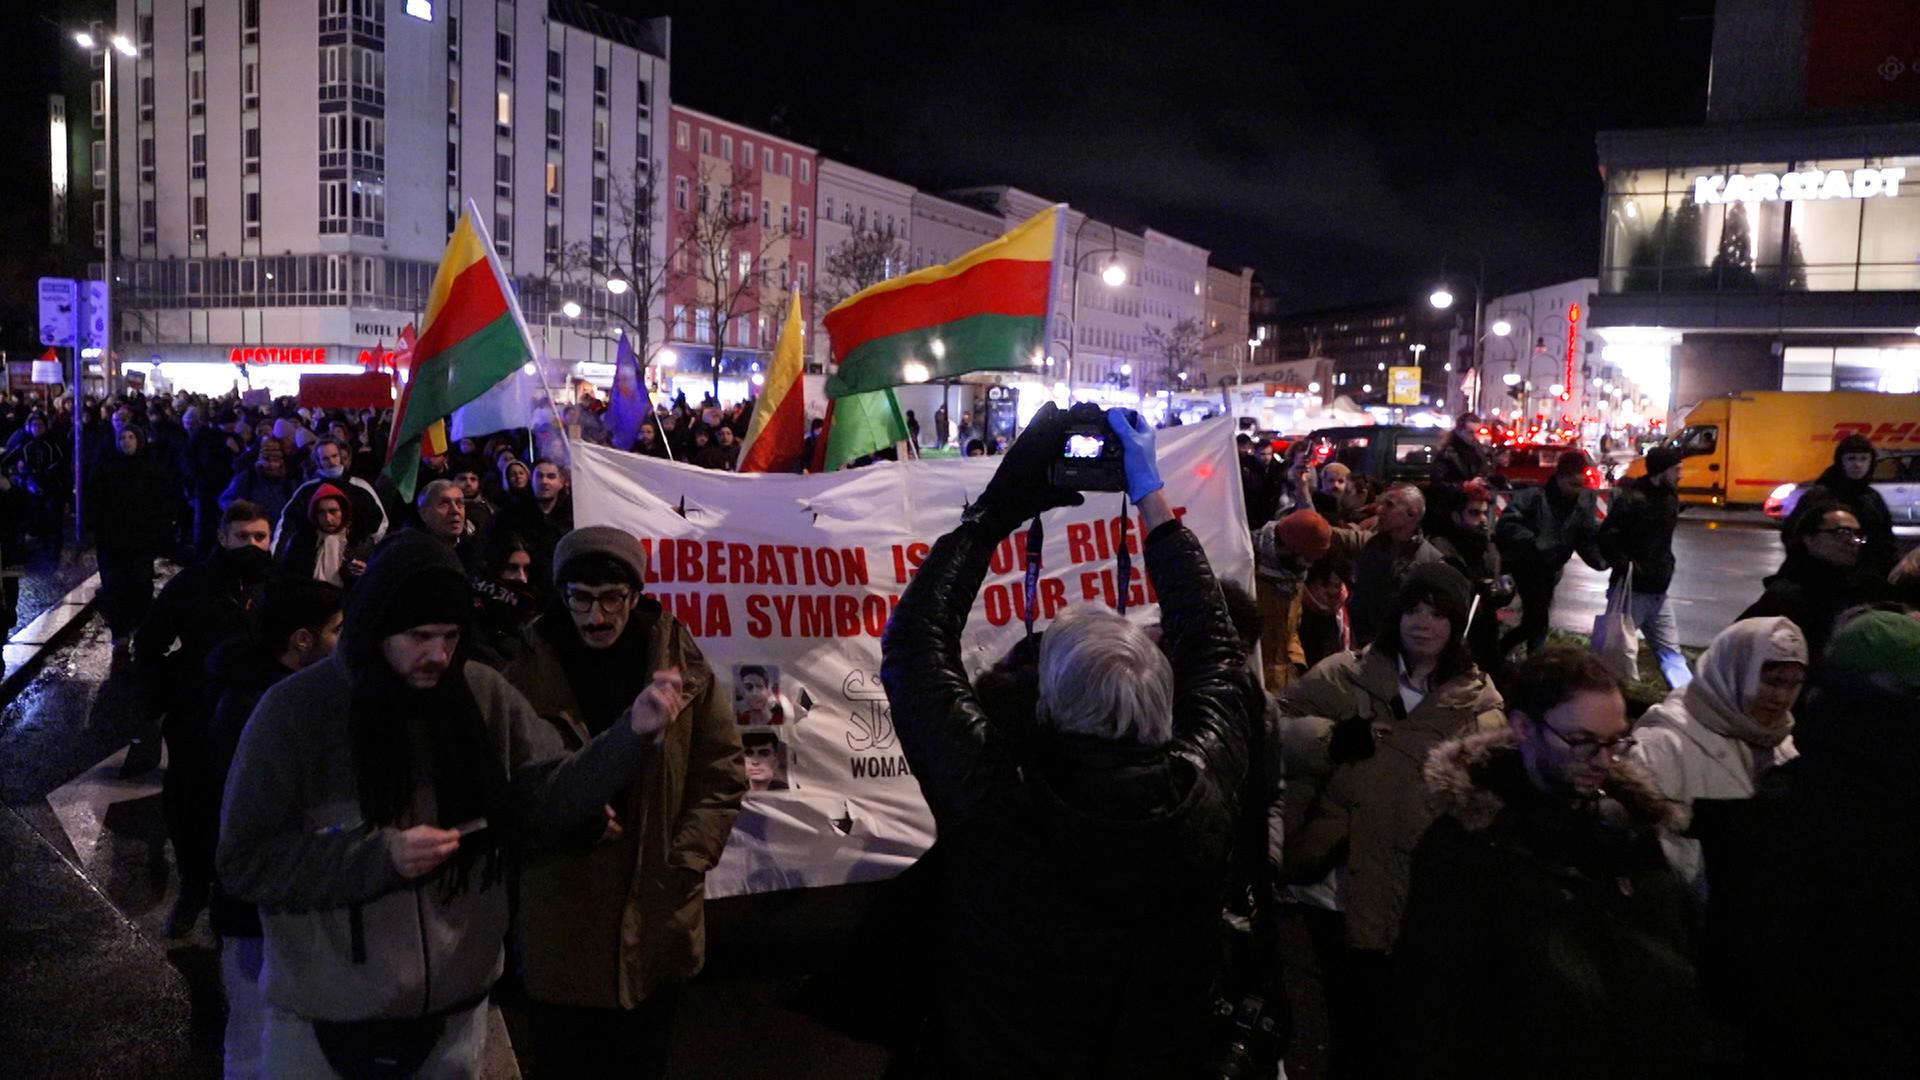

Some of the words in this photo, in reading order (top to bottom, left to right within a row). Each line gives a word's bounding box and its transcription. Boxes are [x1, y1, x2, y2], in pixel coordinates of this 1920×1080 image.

[1694, 167, 1905, 203] KARSTADT
[355, 323, 394, 338] HOTEL
[229, 347, 326, 364] APOTHEKE
[1832, 422, 1920, 442] DH
[640, 539, 868, 587] LIBERATION
[747, 594, 901, 638] SYMBO
[984, 577, 1067, 626] OUR
[851, 756, 909, 778] WOMA
